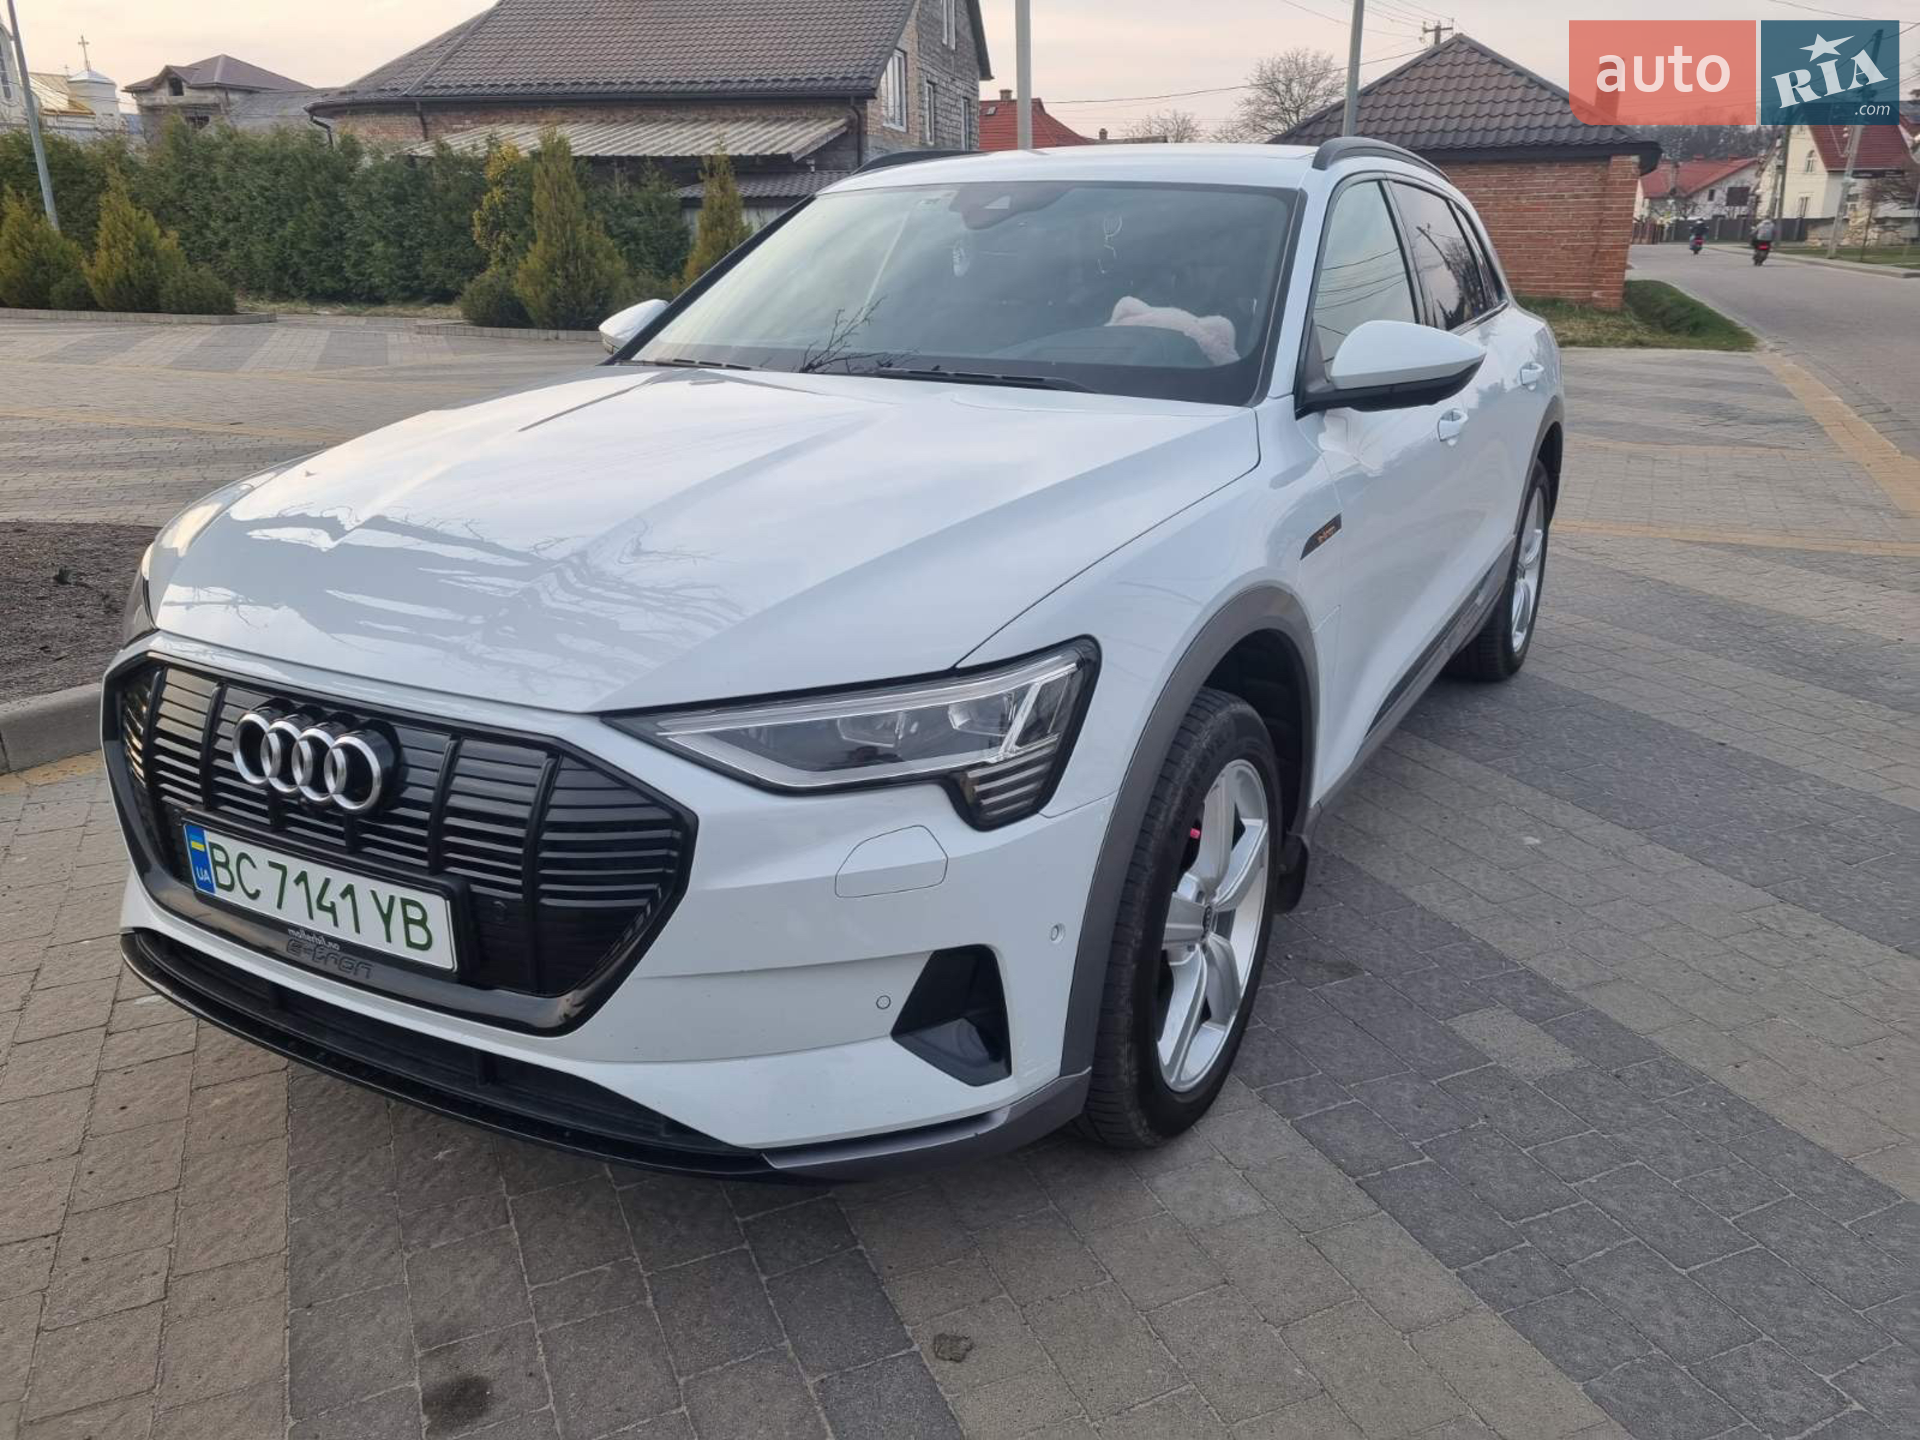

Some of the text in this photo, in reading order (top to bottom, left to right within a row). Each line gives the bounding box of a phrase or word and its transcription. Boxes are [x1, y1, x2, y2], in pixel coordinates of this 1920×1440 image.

[195, 865, 212, 884] UA
[208, 841, 433, 951] BC 7141 YB
